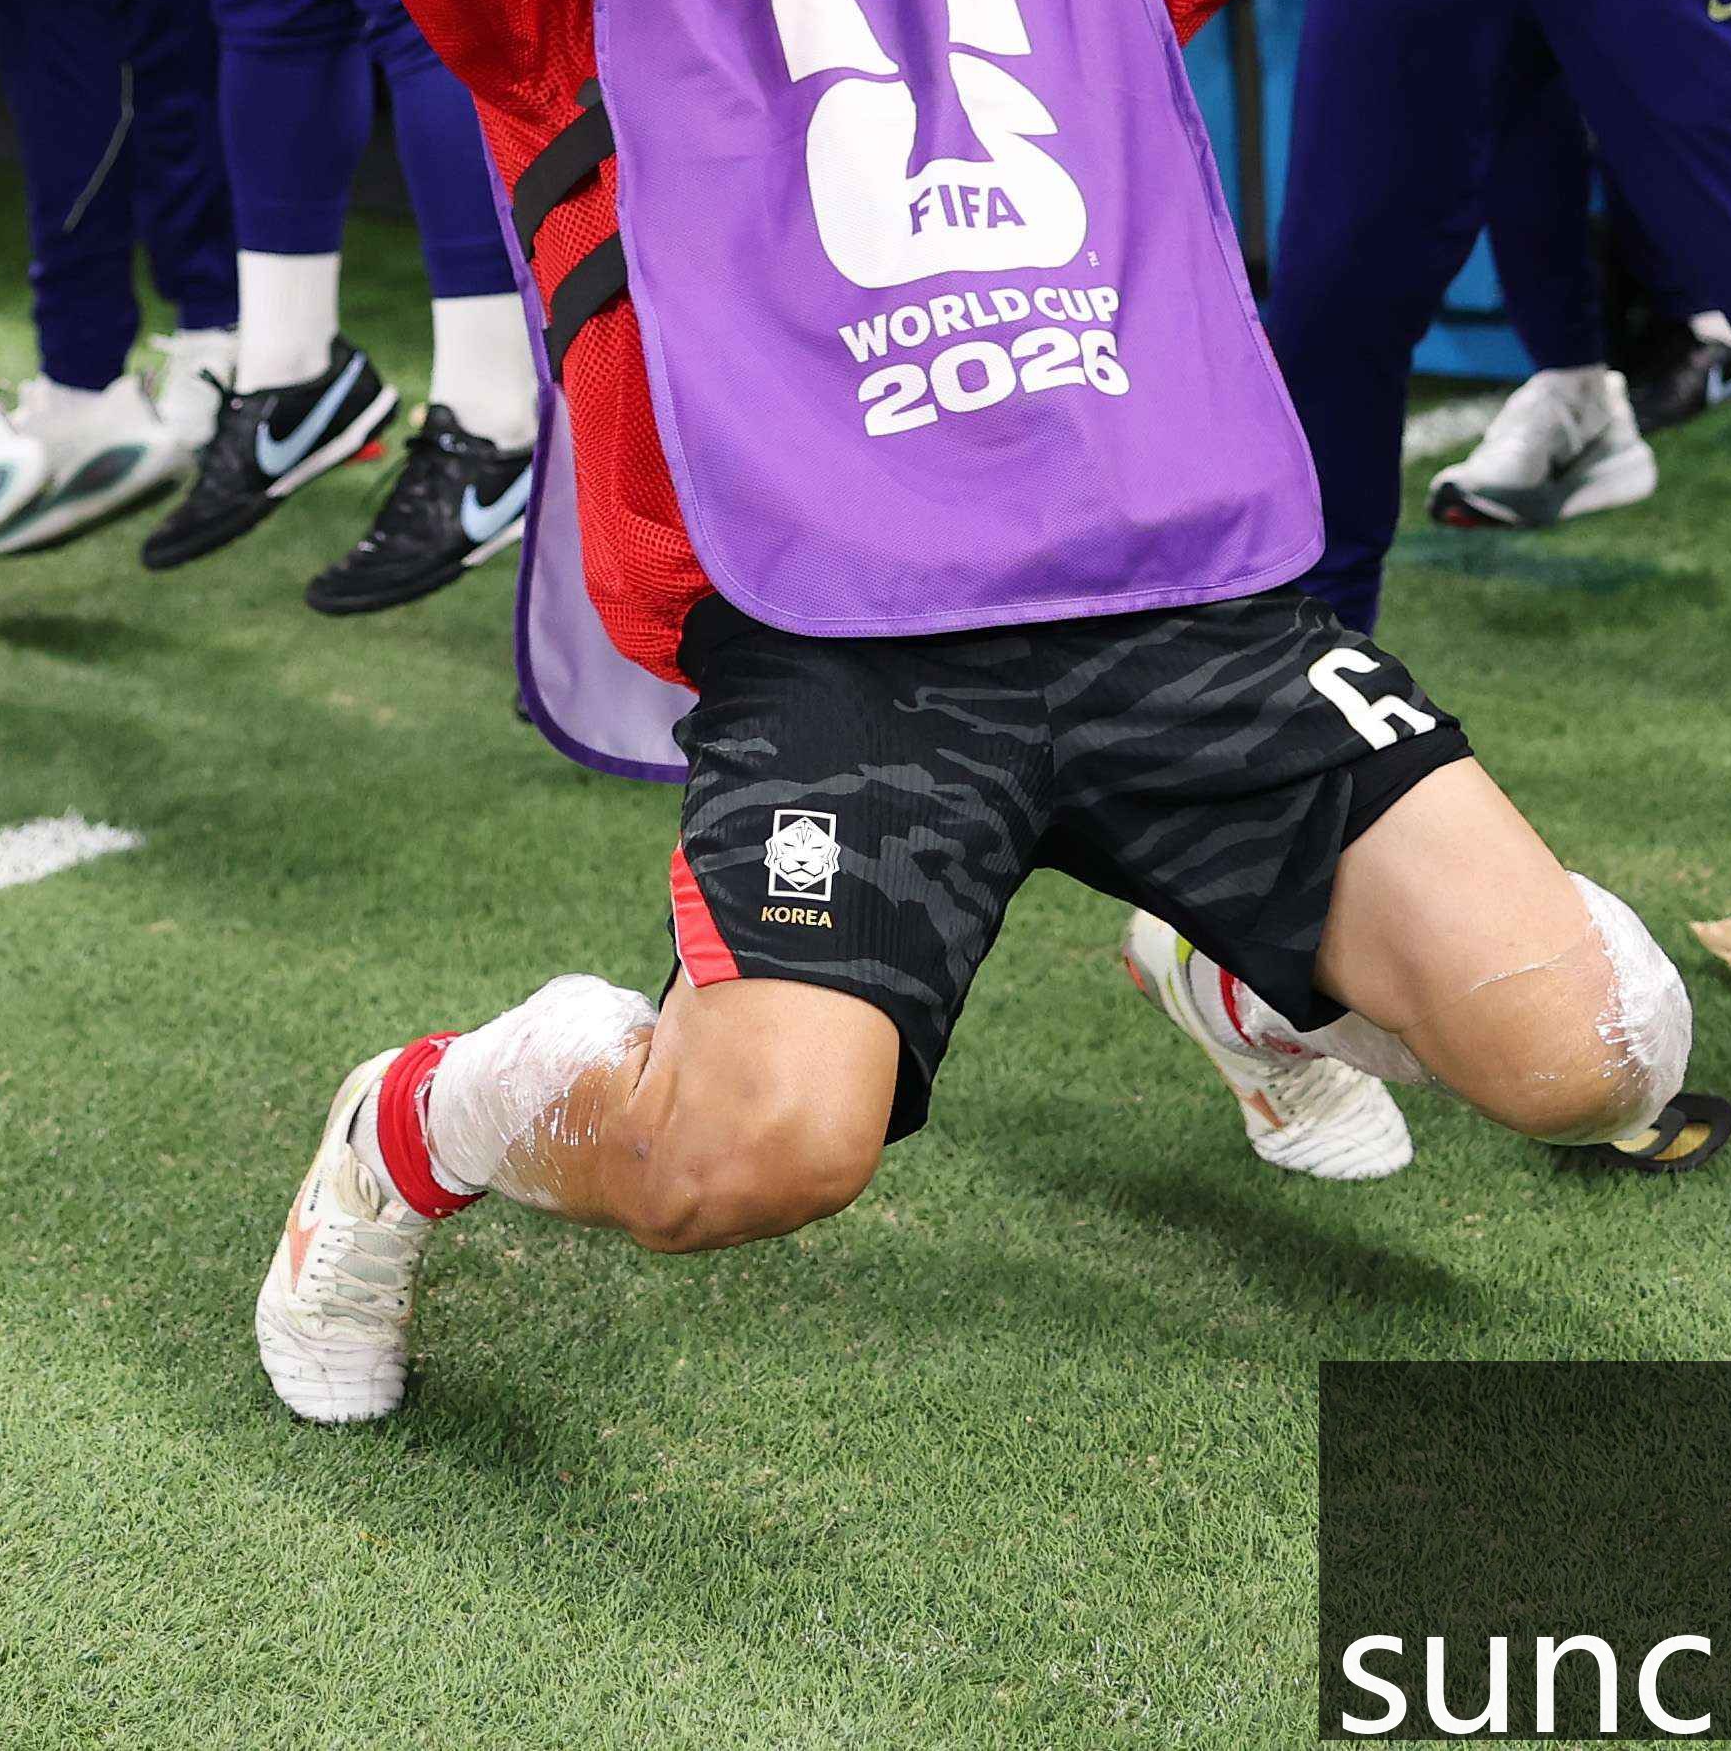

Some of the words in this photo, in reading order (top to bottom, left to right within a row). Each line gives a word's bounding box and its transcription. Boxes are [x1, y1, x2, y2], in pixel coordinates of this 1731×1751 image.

[908, 184, 1027, 237] FIFA
[837, 287, 1032, 364] WORLD
[1032, 285, 1121, 323] CUP
[857, 326, 1132, 438] 2026
[760, 905, 833, 930] KOREA
